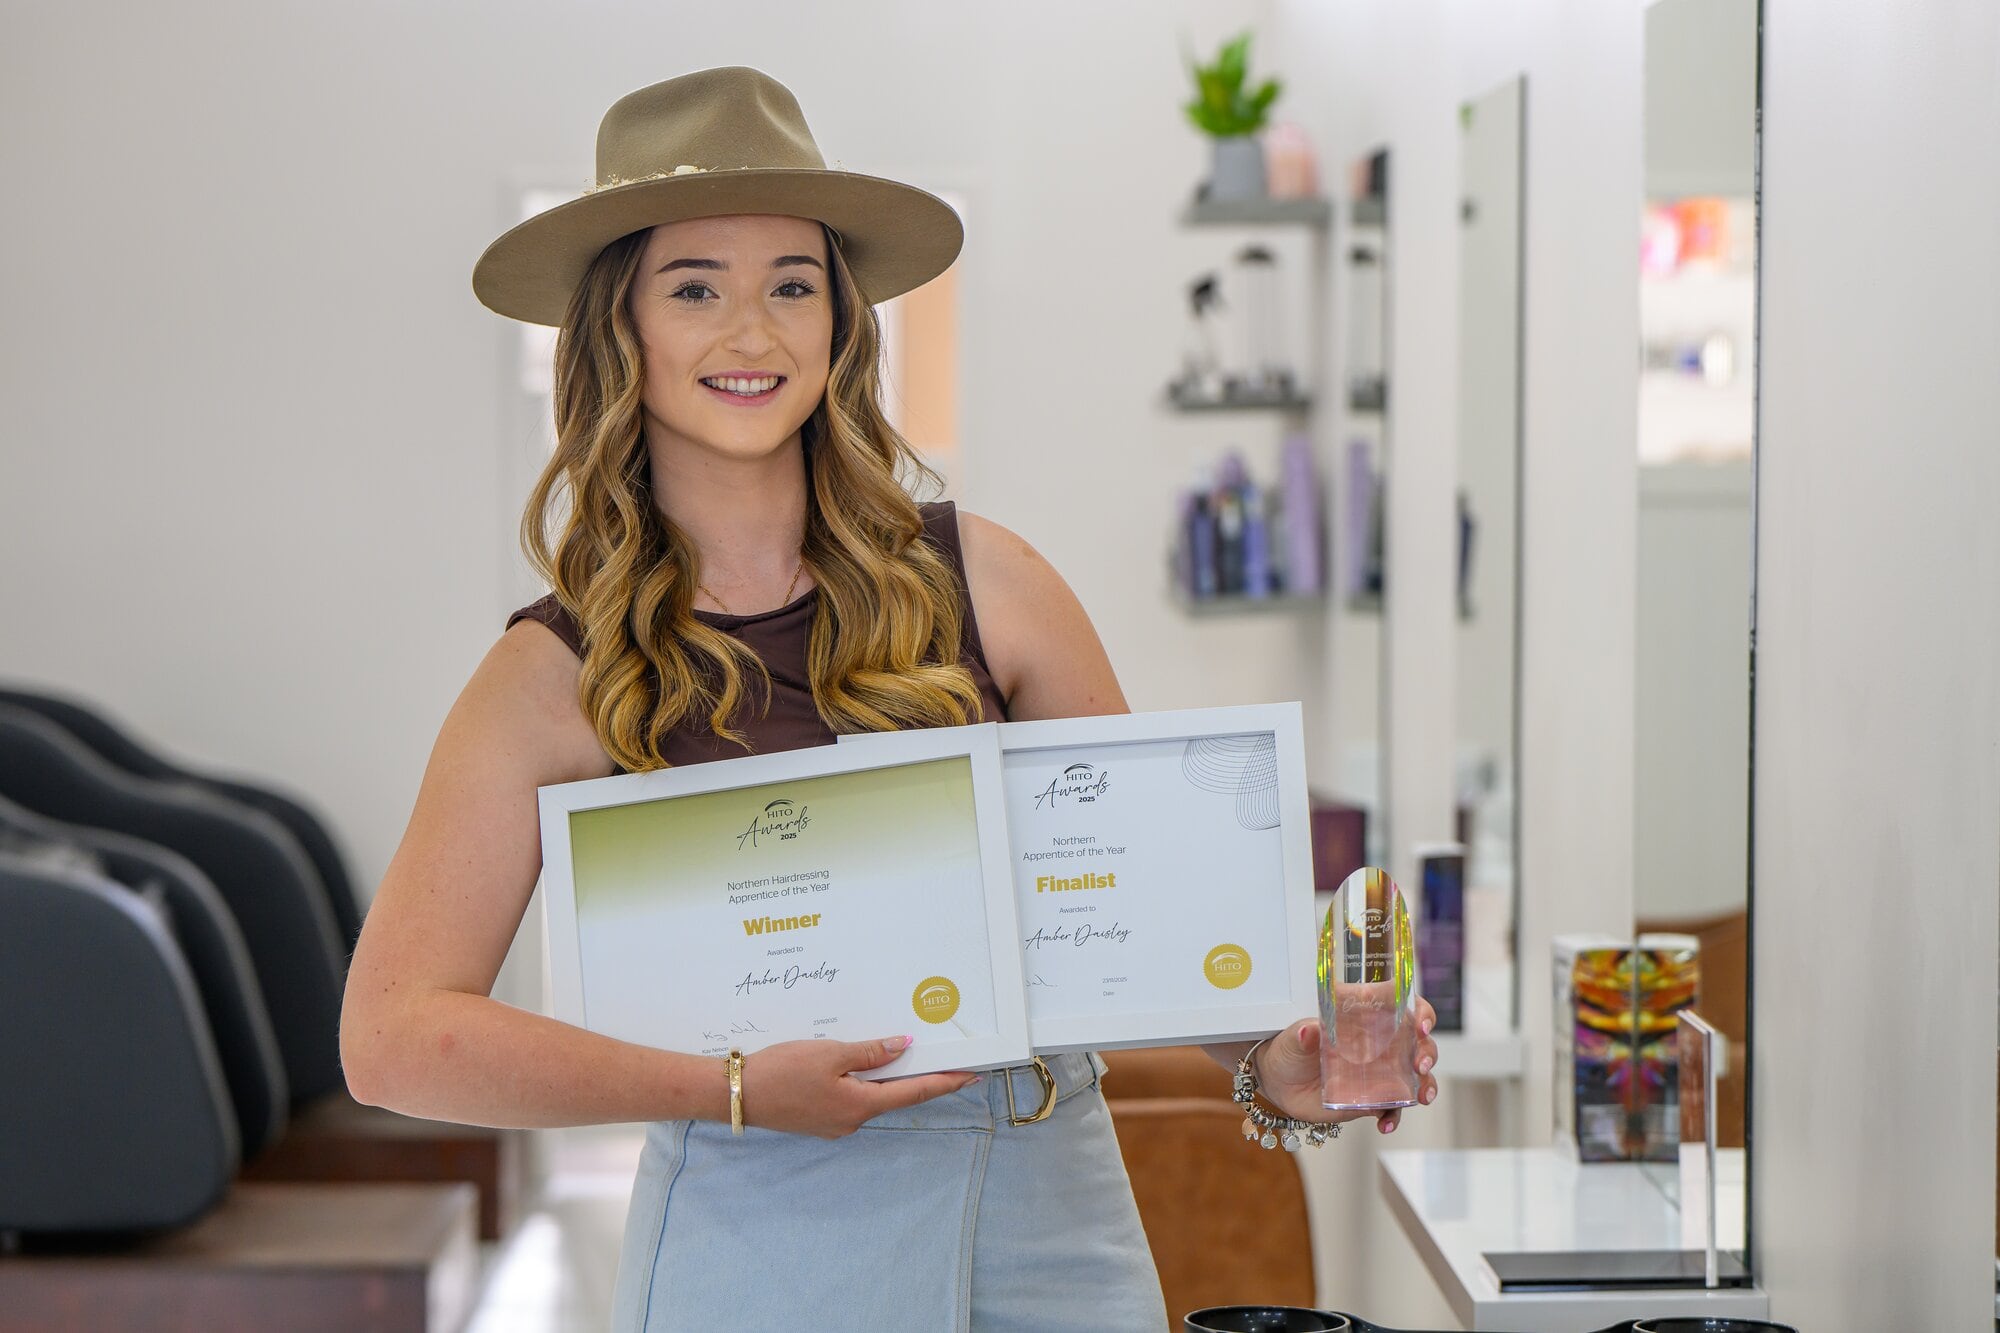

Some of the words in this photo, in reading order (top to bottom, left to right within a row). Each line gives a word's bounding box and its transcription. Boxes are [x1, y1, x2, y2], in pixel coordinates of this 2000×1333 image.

[1066, 771, 1093, 782] HITO
[1034, 771, 1110, 810] Awards
[1078, 795, 1096, 803] 2025
[767, 808, 793, 819] HITO
[736, 806, 811, 850] Awards
[780, 832, 797, 841] 2025
[1052, 836, 1096, 847] Northern
[1023, 850, 1075, 861] Apprentice
[1076, 847, 1086, 857] of
[1088, 847, 1104, 857] the
[1105, 846, 1127, 856] Year
[727, 877, 770, 892] Northern
[771, 869, 830, 885] Hairdressing
[1036, 872, 1117, 893] Finalist
[728, 890, 779, 905] Apprentice
[780, 887, 791, 897] of
[792, 884, 808, 895] the
[809, 881, 831, 893] Year
[1059, 906, 1088, 914] Awarded
[742, 913, 822, 936] Winner
[1025, 926, 1072, 950] Amber
[1074, 921, 1132, 947] Daisley
[766, 947, 796, 957] Awarded
[796, 945, 804, 953] to
[1214, 962, 1242, 971] HITO
[735, 968, 780, 996] Amber
[783, 961, 840, 989] Daisley
[923, 995, 950, 1006] HITO
